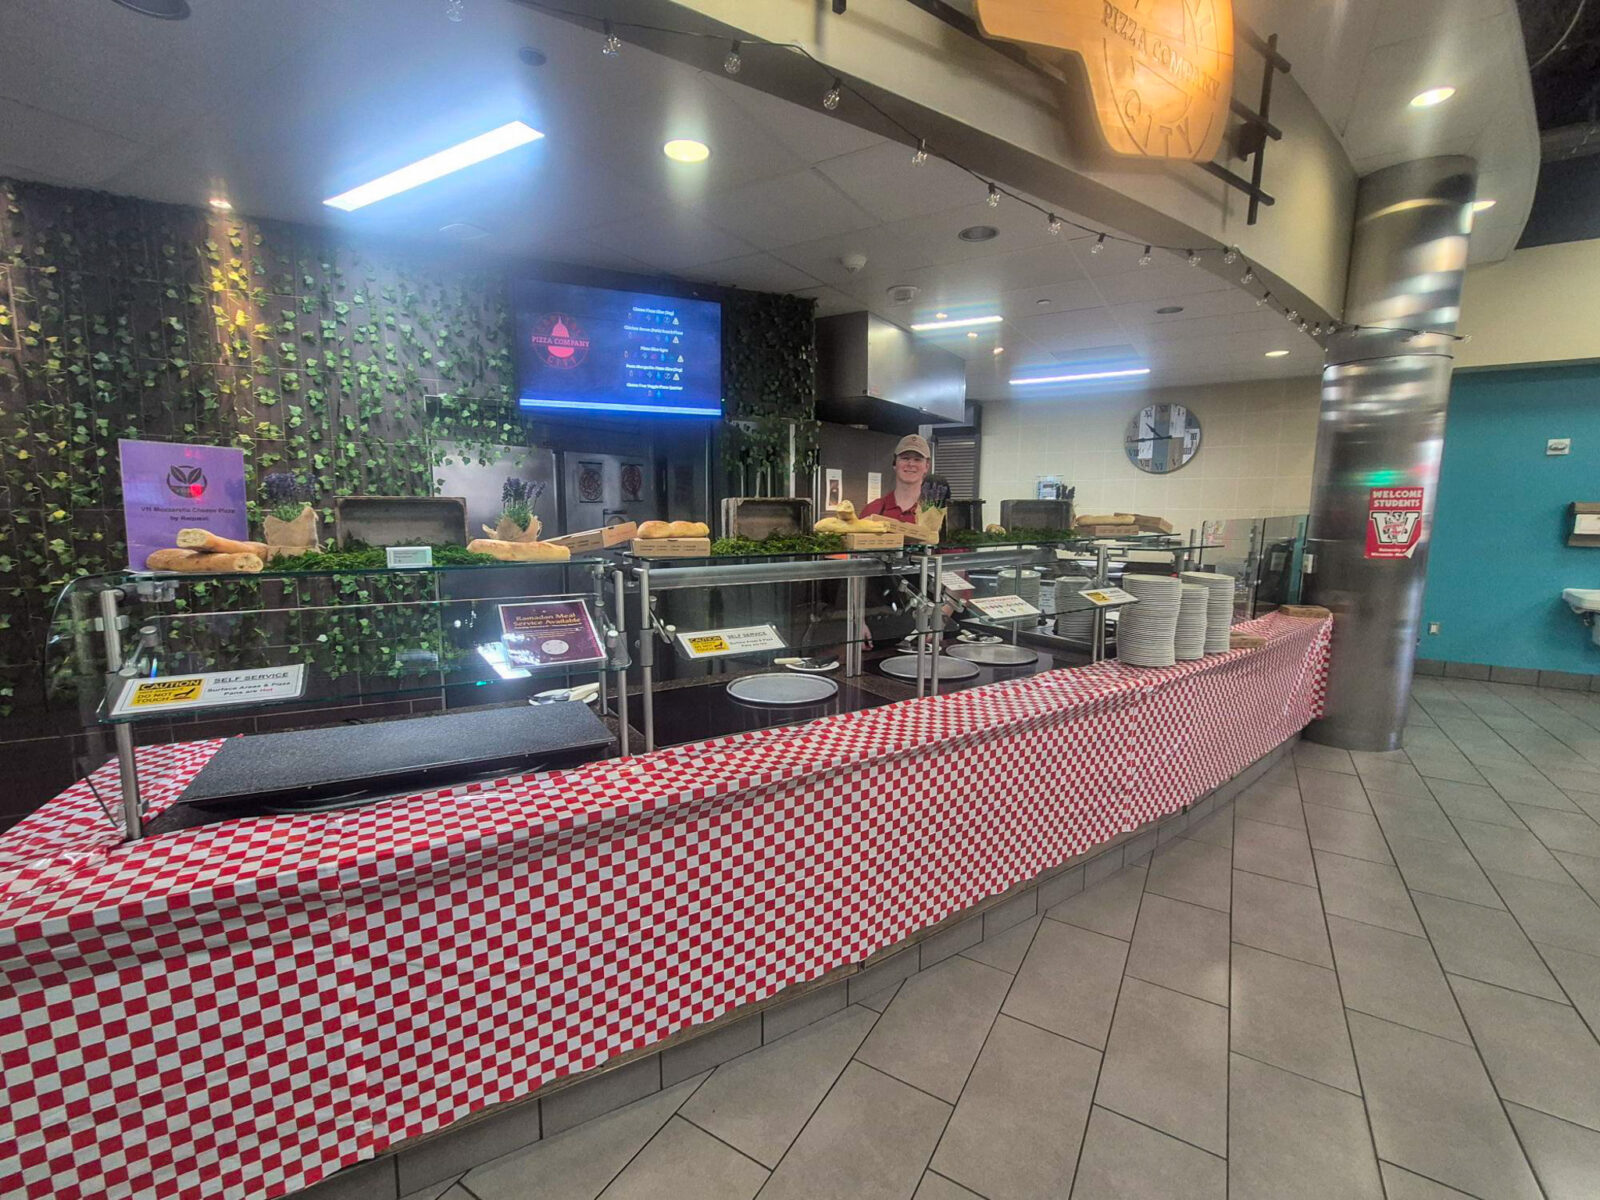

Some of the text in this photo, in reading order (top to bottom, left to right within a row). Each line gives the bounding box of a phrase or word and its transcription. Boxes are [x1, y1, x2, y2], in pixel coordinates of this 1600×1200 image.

[1103, 2, 1147, 55] PIZZA
[1152, 40, 1220, 101] COMPANY
[532, 335, 590, 347] PIZZA COMPANY
[1373, 489, 1423, 498] WELCOME
[1373, 499, 1420, 507] STUDENTS
[513, 619, 543, 627] Service
[214, 672, 289, 684] SELF SERVICE
[140, 680, 201, 690] CAUTION
